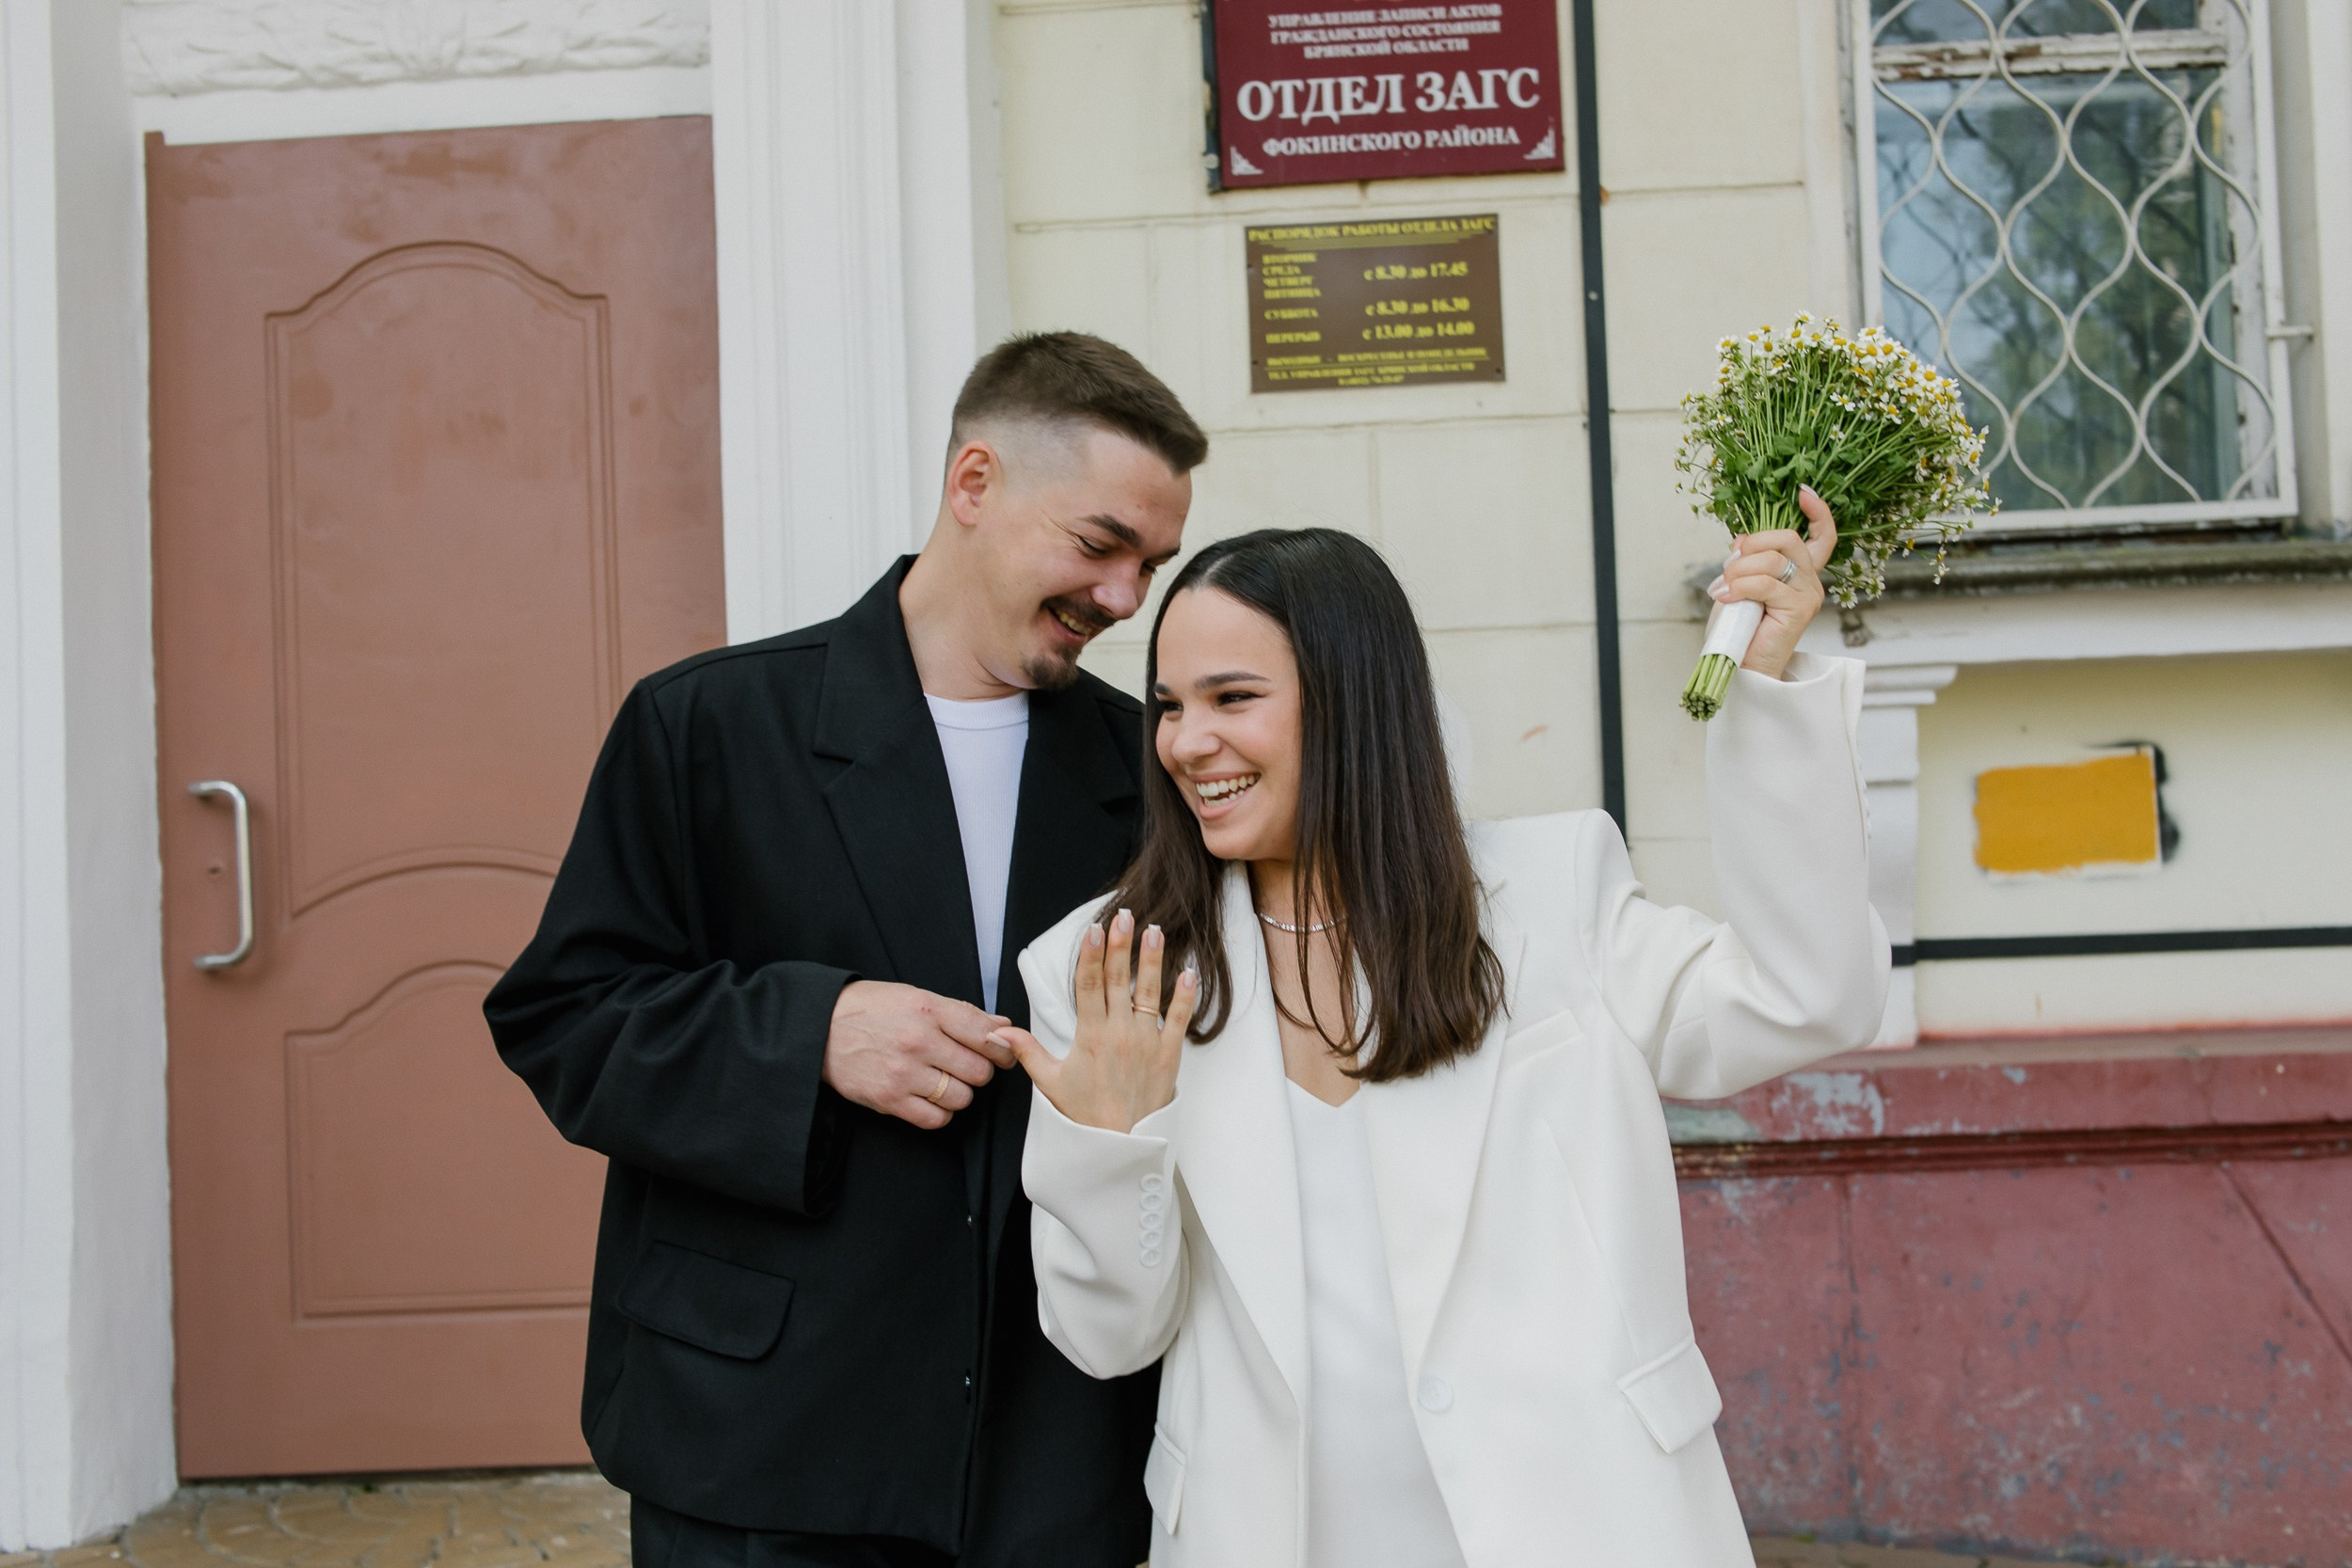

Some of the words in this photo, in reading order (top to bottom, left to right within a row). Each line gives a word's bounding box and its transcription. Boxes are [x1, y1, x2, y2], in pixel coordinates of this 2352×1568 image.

[1449, 4, 1502, 18] АКТОВ
[1271, 25, 1400, 44] ГРАЖДАНСКОГО
[1402, 20, 1501, 38] СОСТОЯНИЯ
[1304, 40, 1391, 59] БРЯНСКОЙ
[1393, 38, 1469, 54] ОБЛАСТИ
[1236, 73, 1406, 126] ОТДЕЛ
[1416, 67, 1541, 112] ЗАГС
[1263, 129, 1422, 157] ФОКИНСКОГО
[1424, 124, 1520, 149] РАЙОНА
